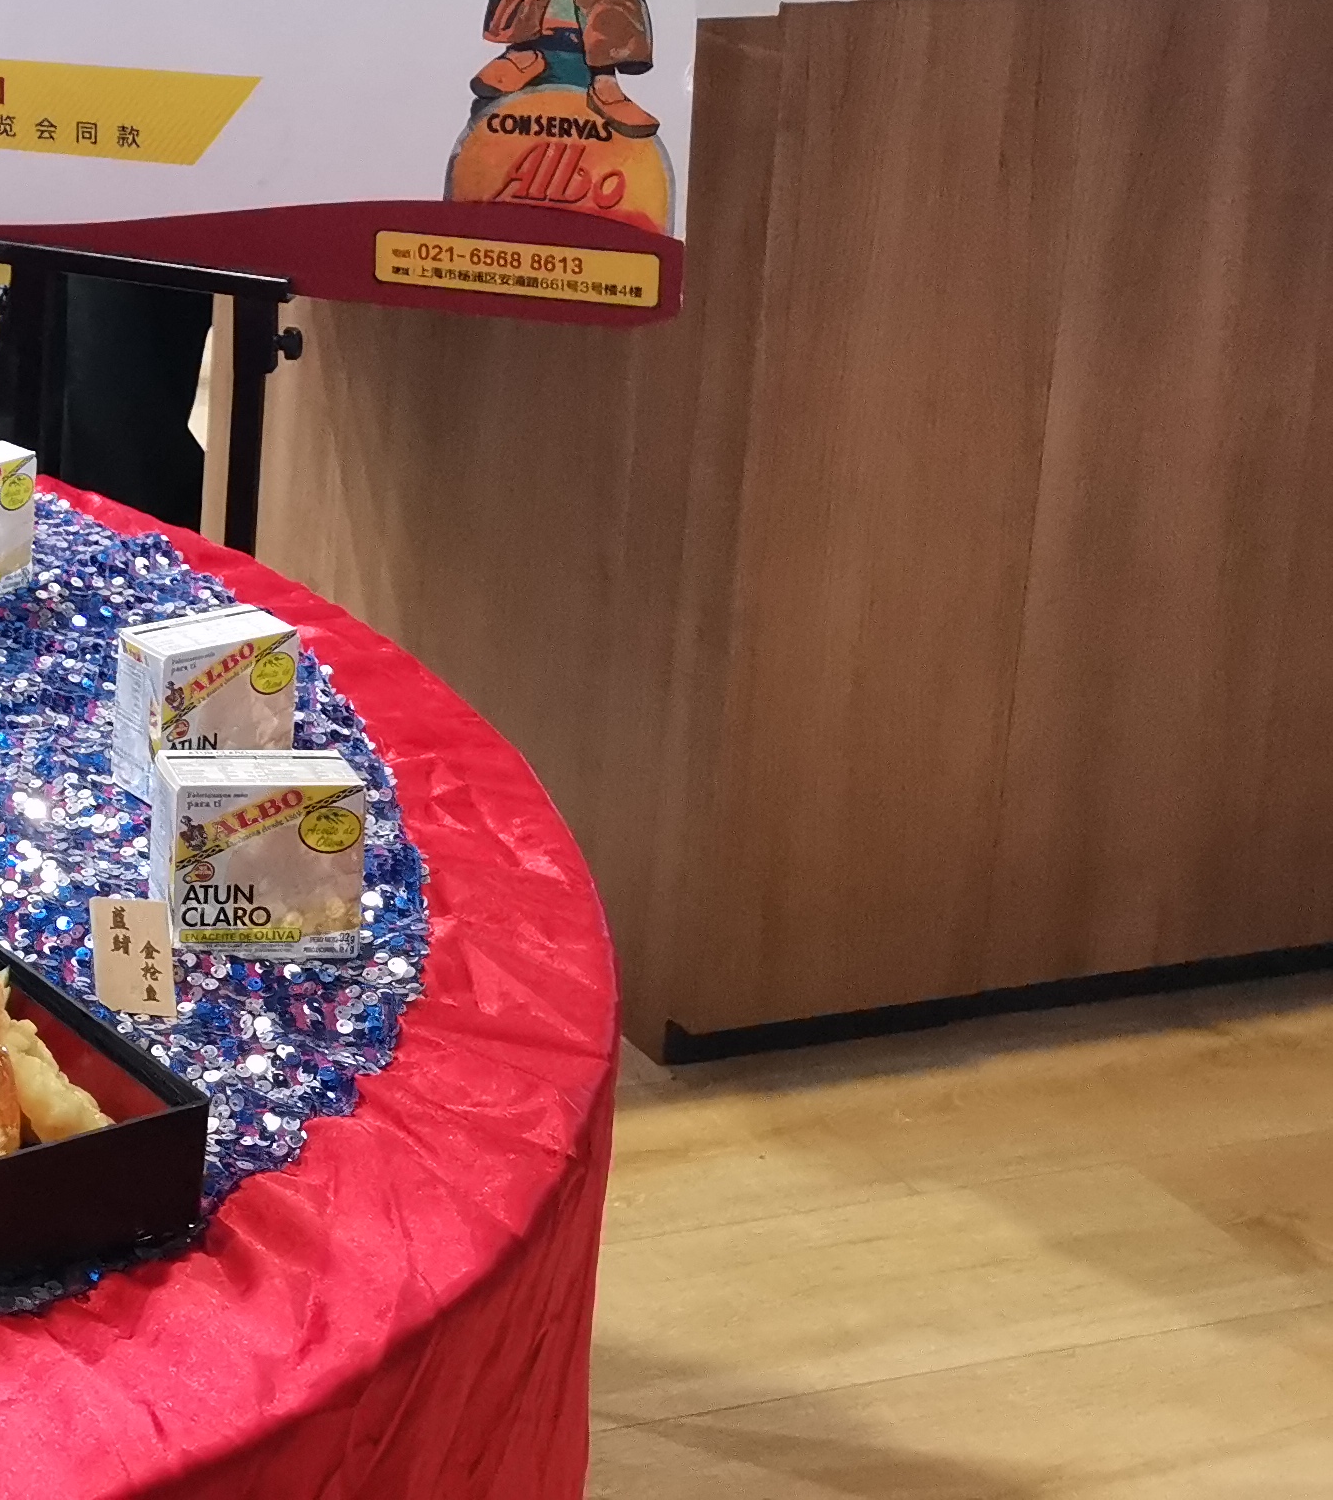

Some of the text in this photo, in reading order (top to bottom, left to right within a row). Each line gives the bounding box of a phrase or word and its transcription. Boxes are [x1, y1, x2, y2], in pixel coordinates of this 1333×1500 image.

[486, 113, 613, 142] CONSERVAS
[492, 142, 627, 210] Albo
[417, 243, 584, 276] 021-6568 8613
[190, 642, 254, 699] ALBO
[187, 800, 212, 811] para
[212, 788, 304, 842] ALBO
[182, 884, 255, 905] ATUN
[181, 906, 272, 928] CLARO
[185, 929, 295, 942] EN ACEITE DE OLIVA
